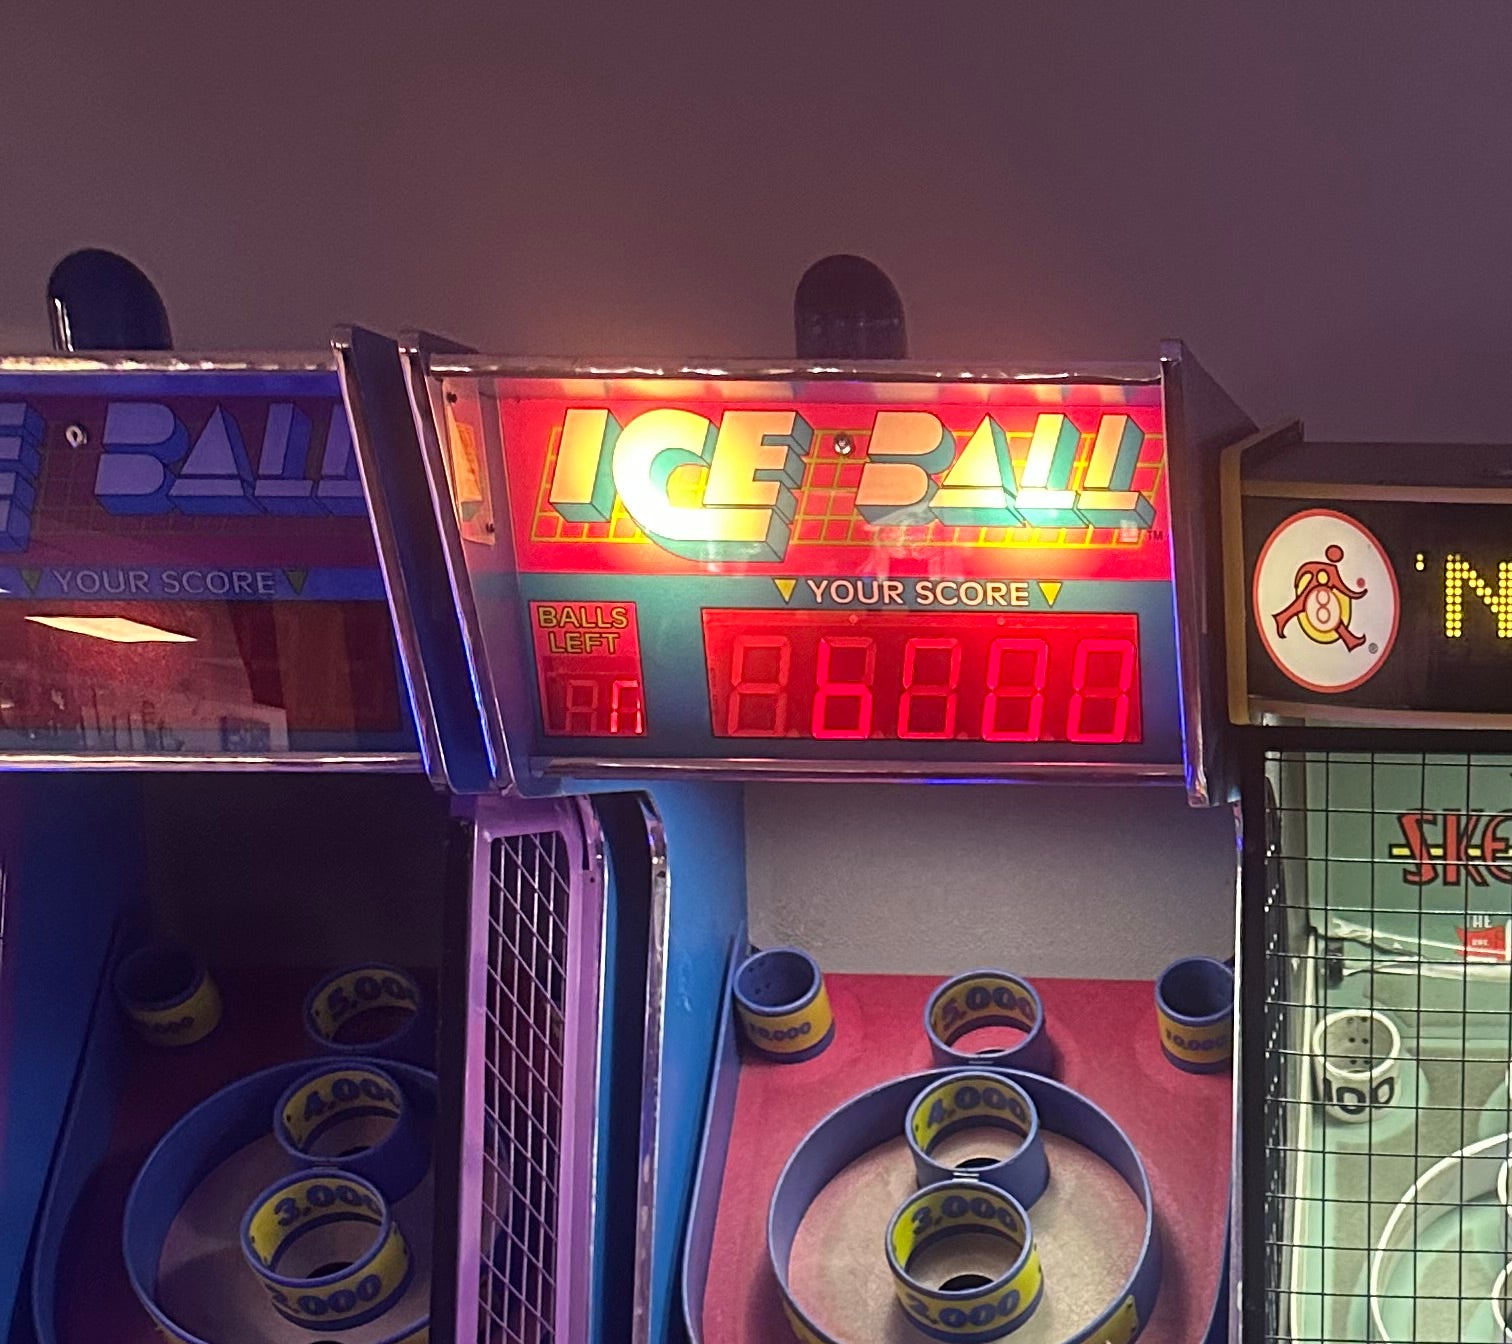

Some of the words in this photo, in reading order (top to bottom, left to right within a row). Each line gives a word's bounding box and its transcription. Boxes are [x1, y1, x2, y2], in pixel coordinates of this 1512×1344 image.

[549, 407, 813, 563] ICE
[855, 411, 1156, 528] BALL
[53, 569, 157, 596] YOUR
[163, 570, 277, 597] SCORE
[808, 579, 904, 606] YOUR
[915, 580, 1030, 607] SCORE
[537, 605, 629, 629] BALLS
[549, 631, 621, 655] LEFT
